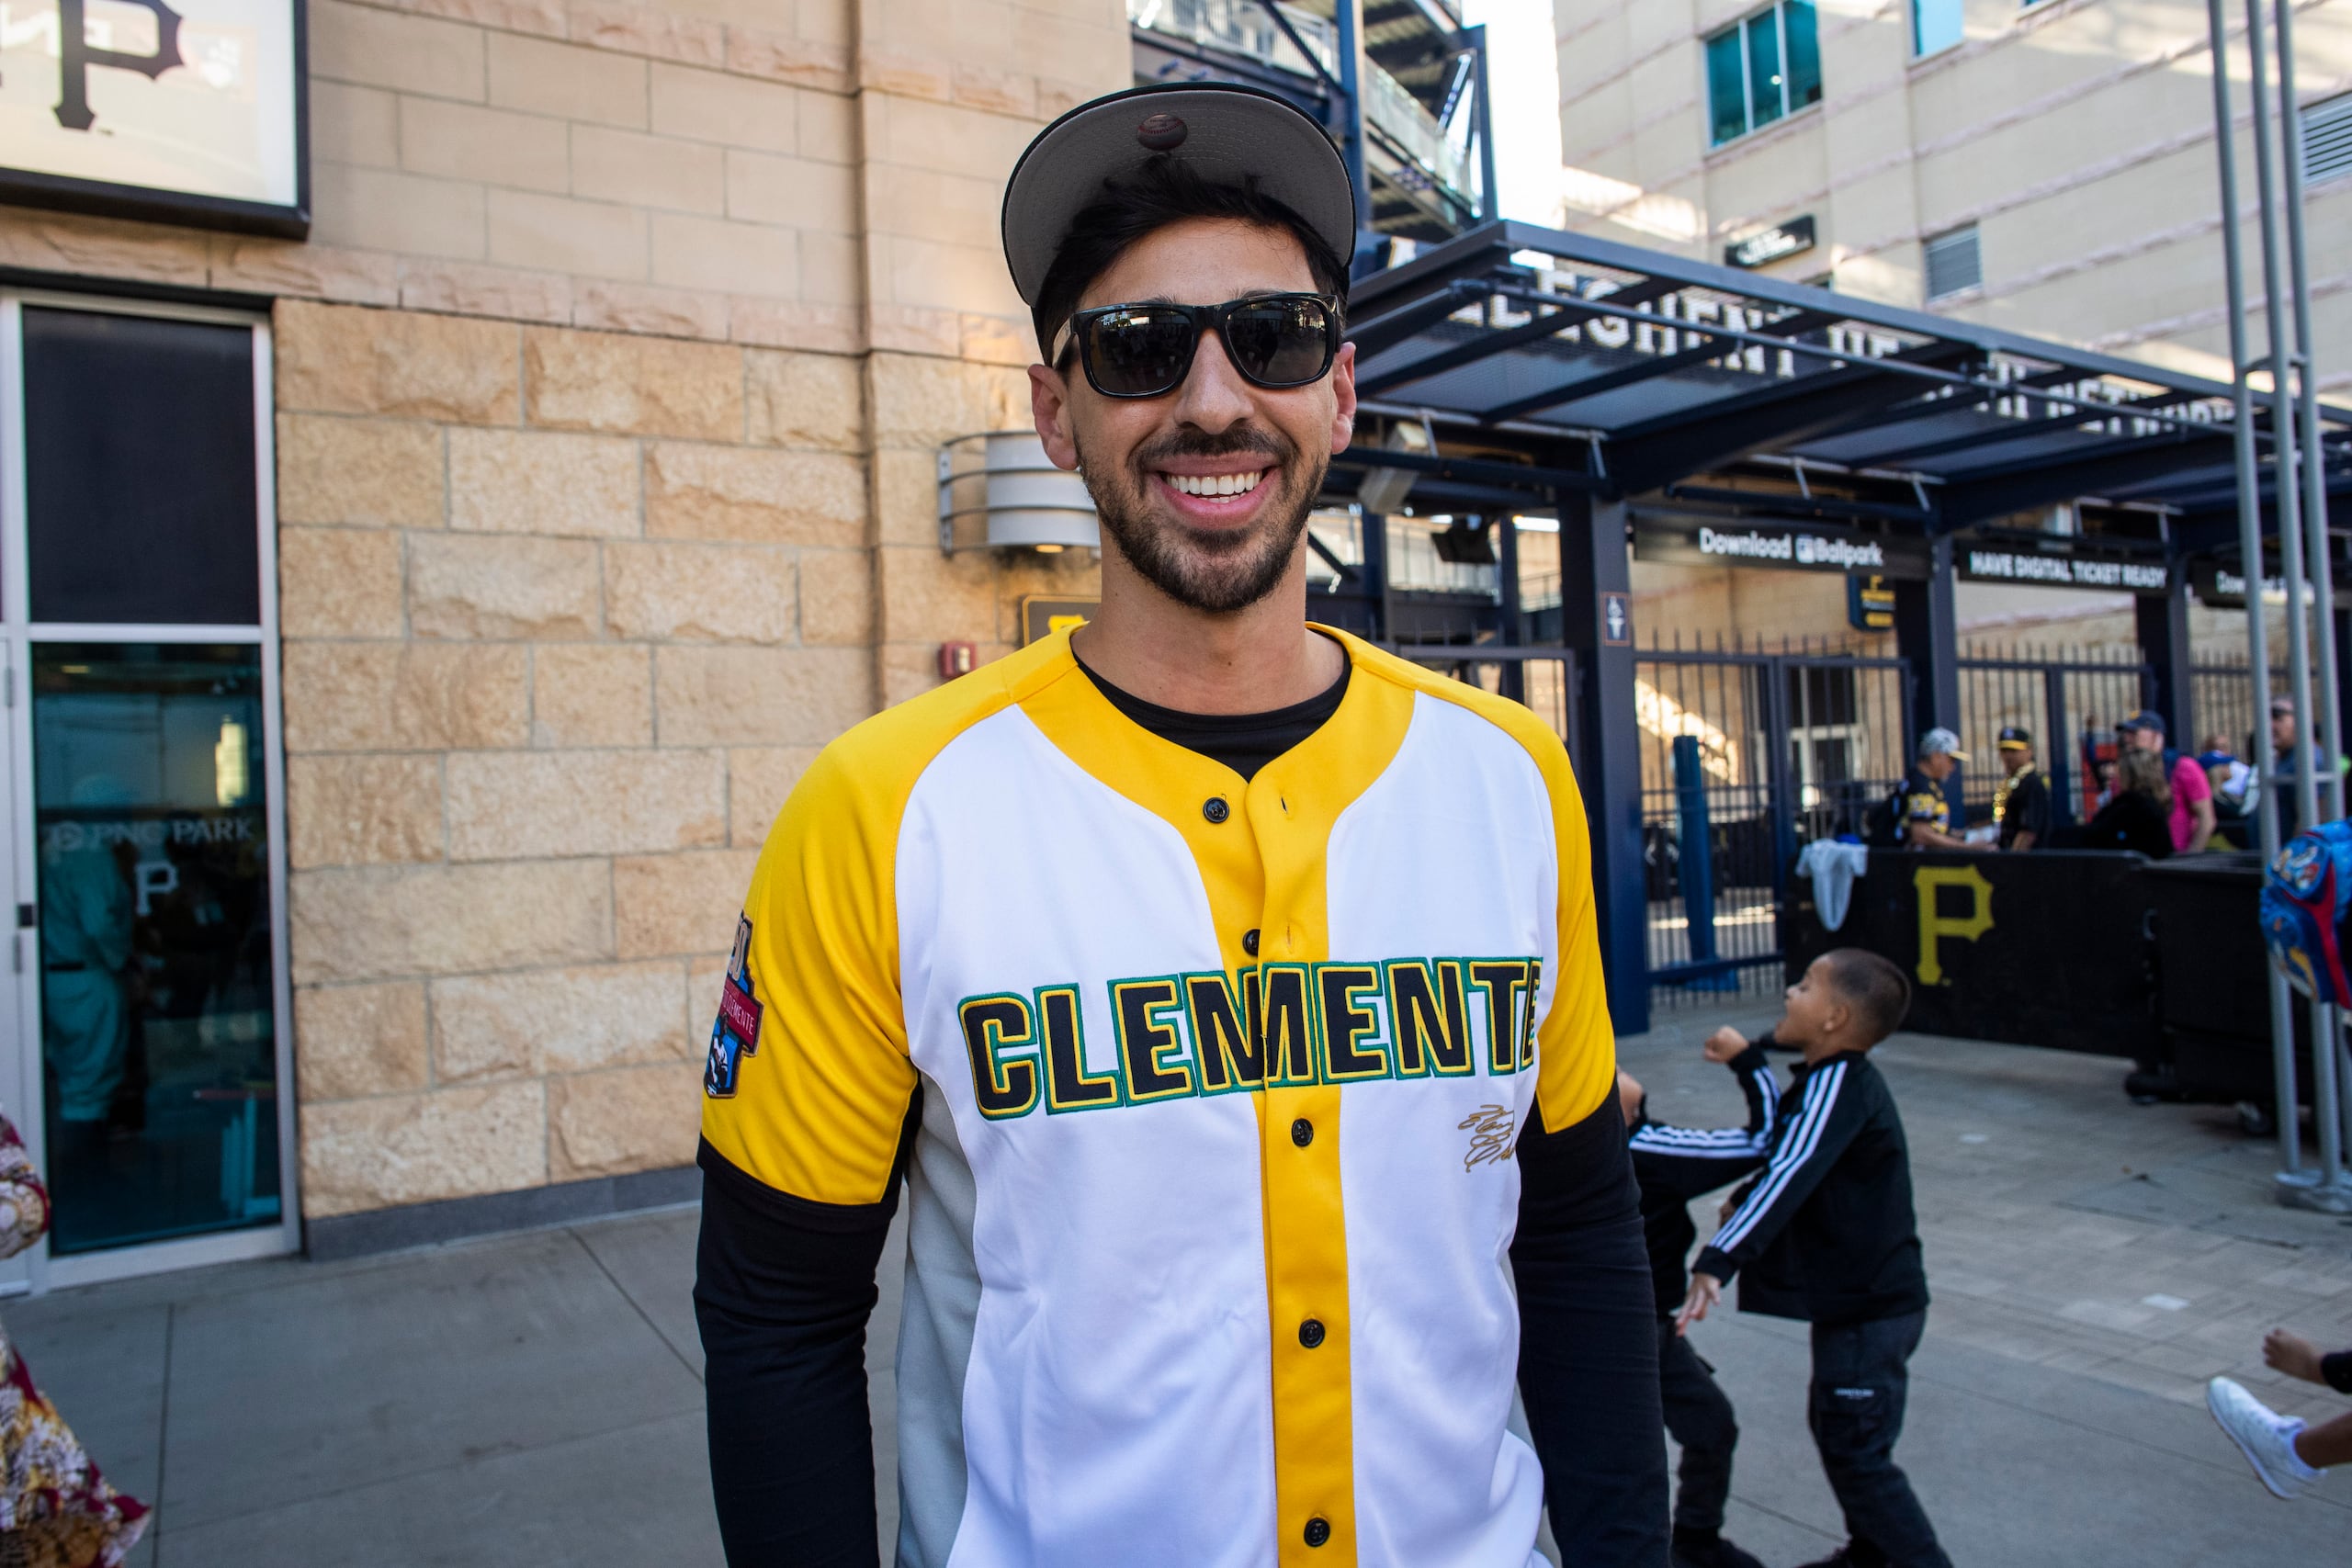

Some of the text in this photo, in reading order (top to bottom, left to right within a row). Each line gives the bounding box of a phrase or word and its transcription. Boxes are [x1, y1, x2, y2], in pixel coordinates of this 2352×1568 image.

[1699, 527, 1883, 570] Download Ballpark
[1970, 551, 2167, 588] HAVE DIGITAL TICKET READY
[173, 817, 254, 844] PARK
[134, 860, 180, 917] P
[1914, 864, 1994, 985] P
[957, 956, 1544, 1121] CLEMENTE
